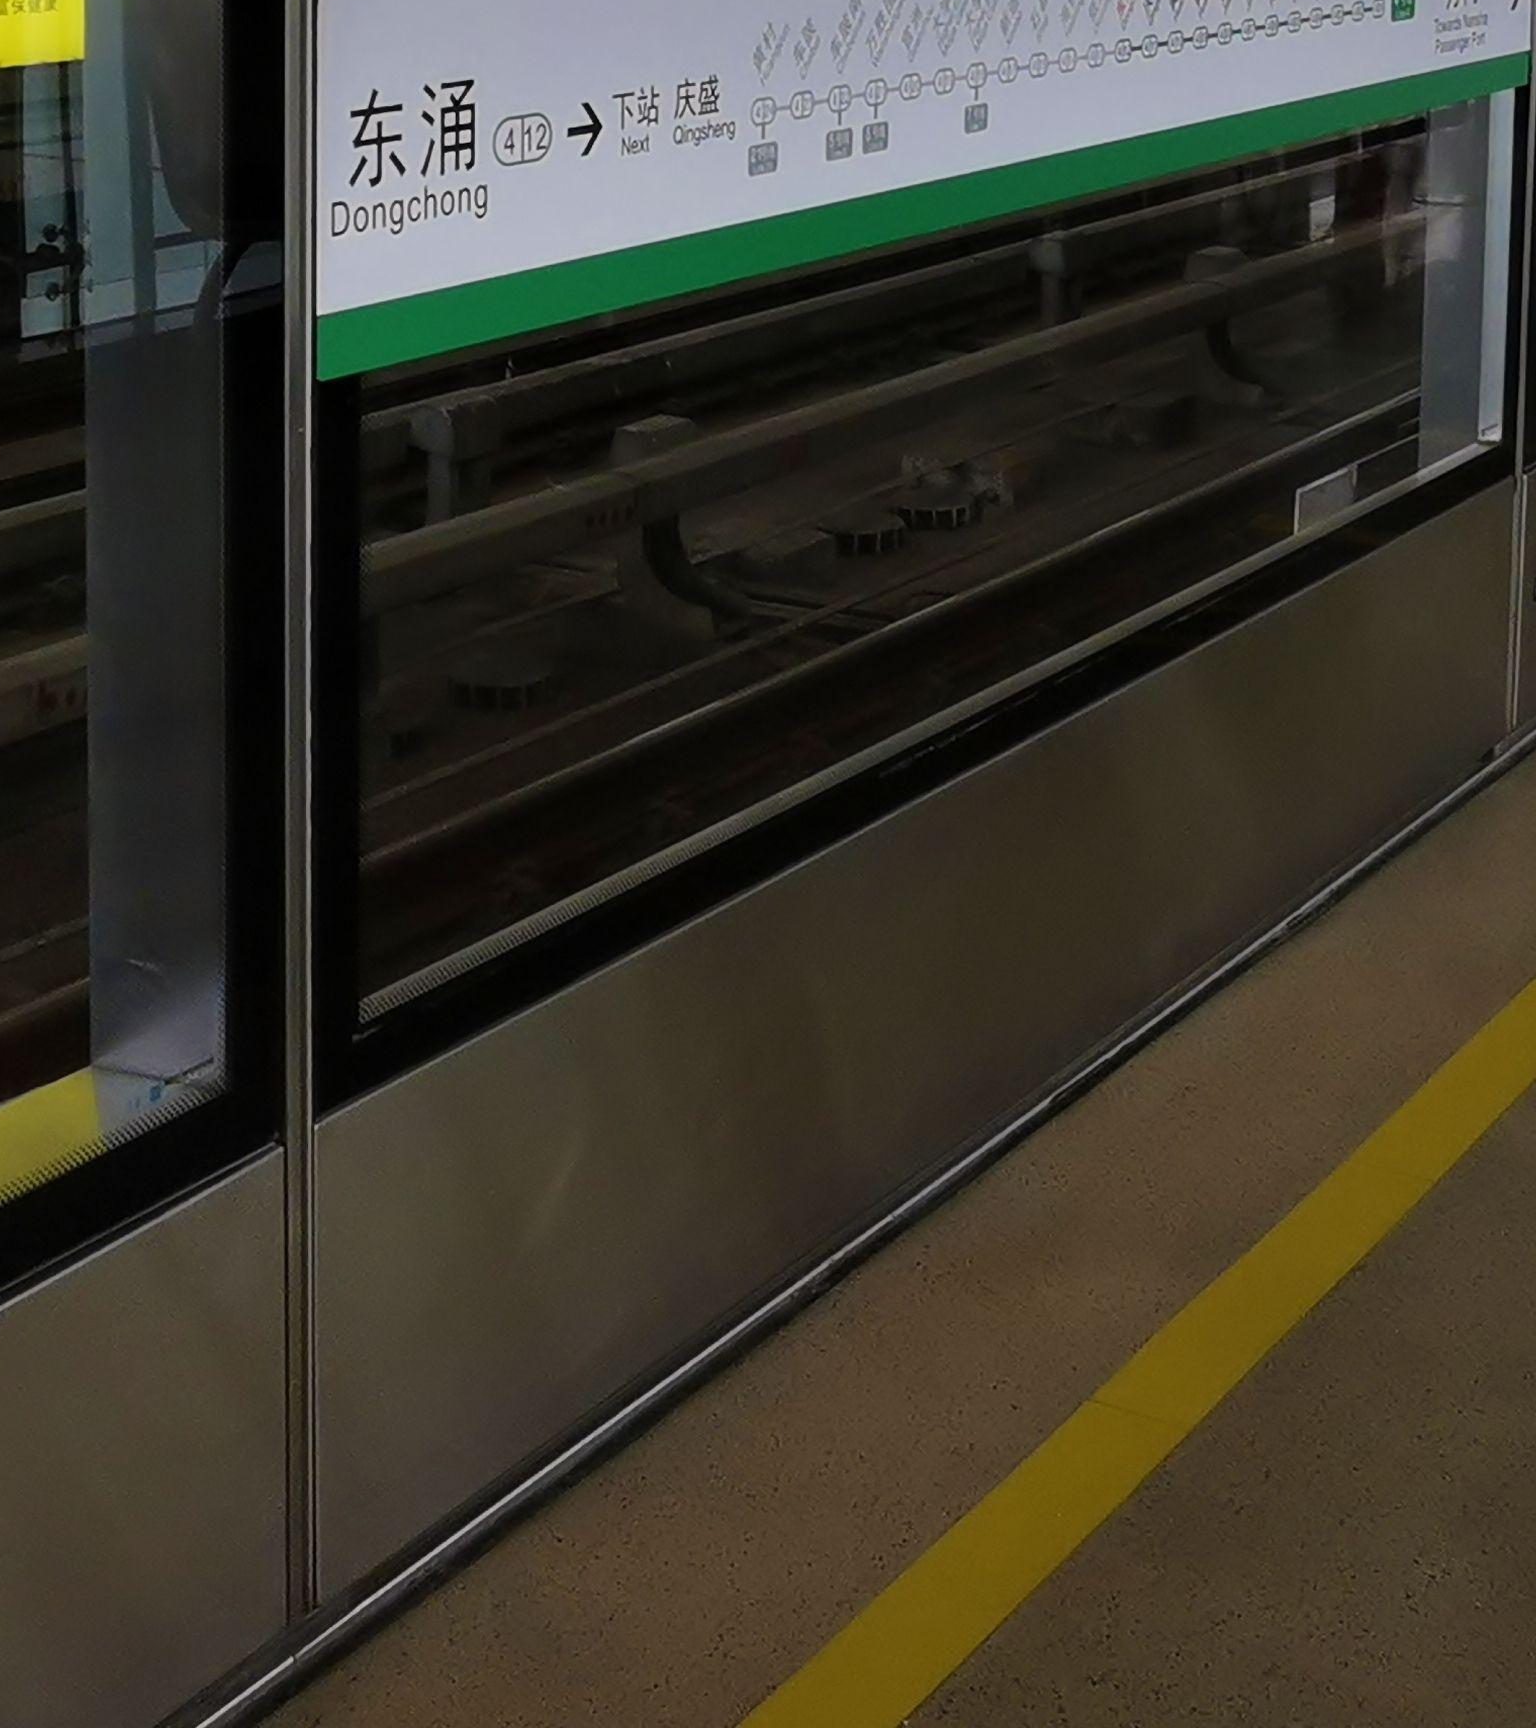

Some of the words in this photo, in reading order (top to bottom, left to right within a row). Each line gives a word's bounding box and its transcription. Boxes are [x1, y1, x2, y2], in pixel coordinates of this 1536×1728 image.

[612, 86, 660, 131] 下站
[673, 74, 721, 121] 庆盛
[348, 78, 478, 189] 东涌
[621, 134, 651, 157] Next
[672, 119, 737, 147] Qingsheng
[330, 182, 489, 239] Dongchong
